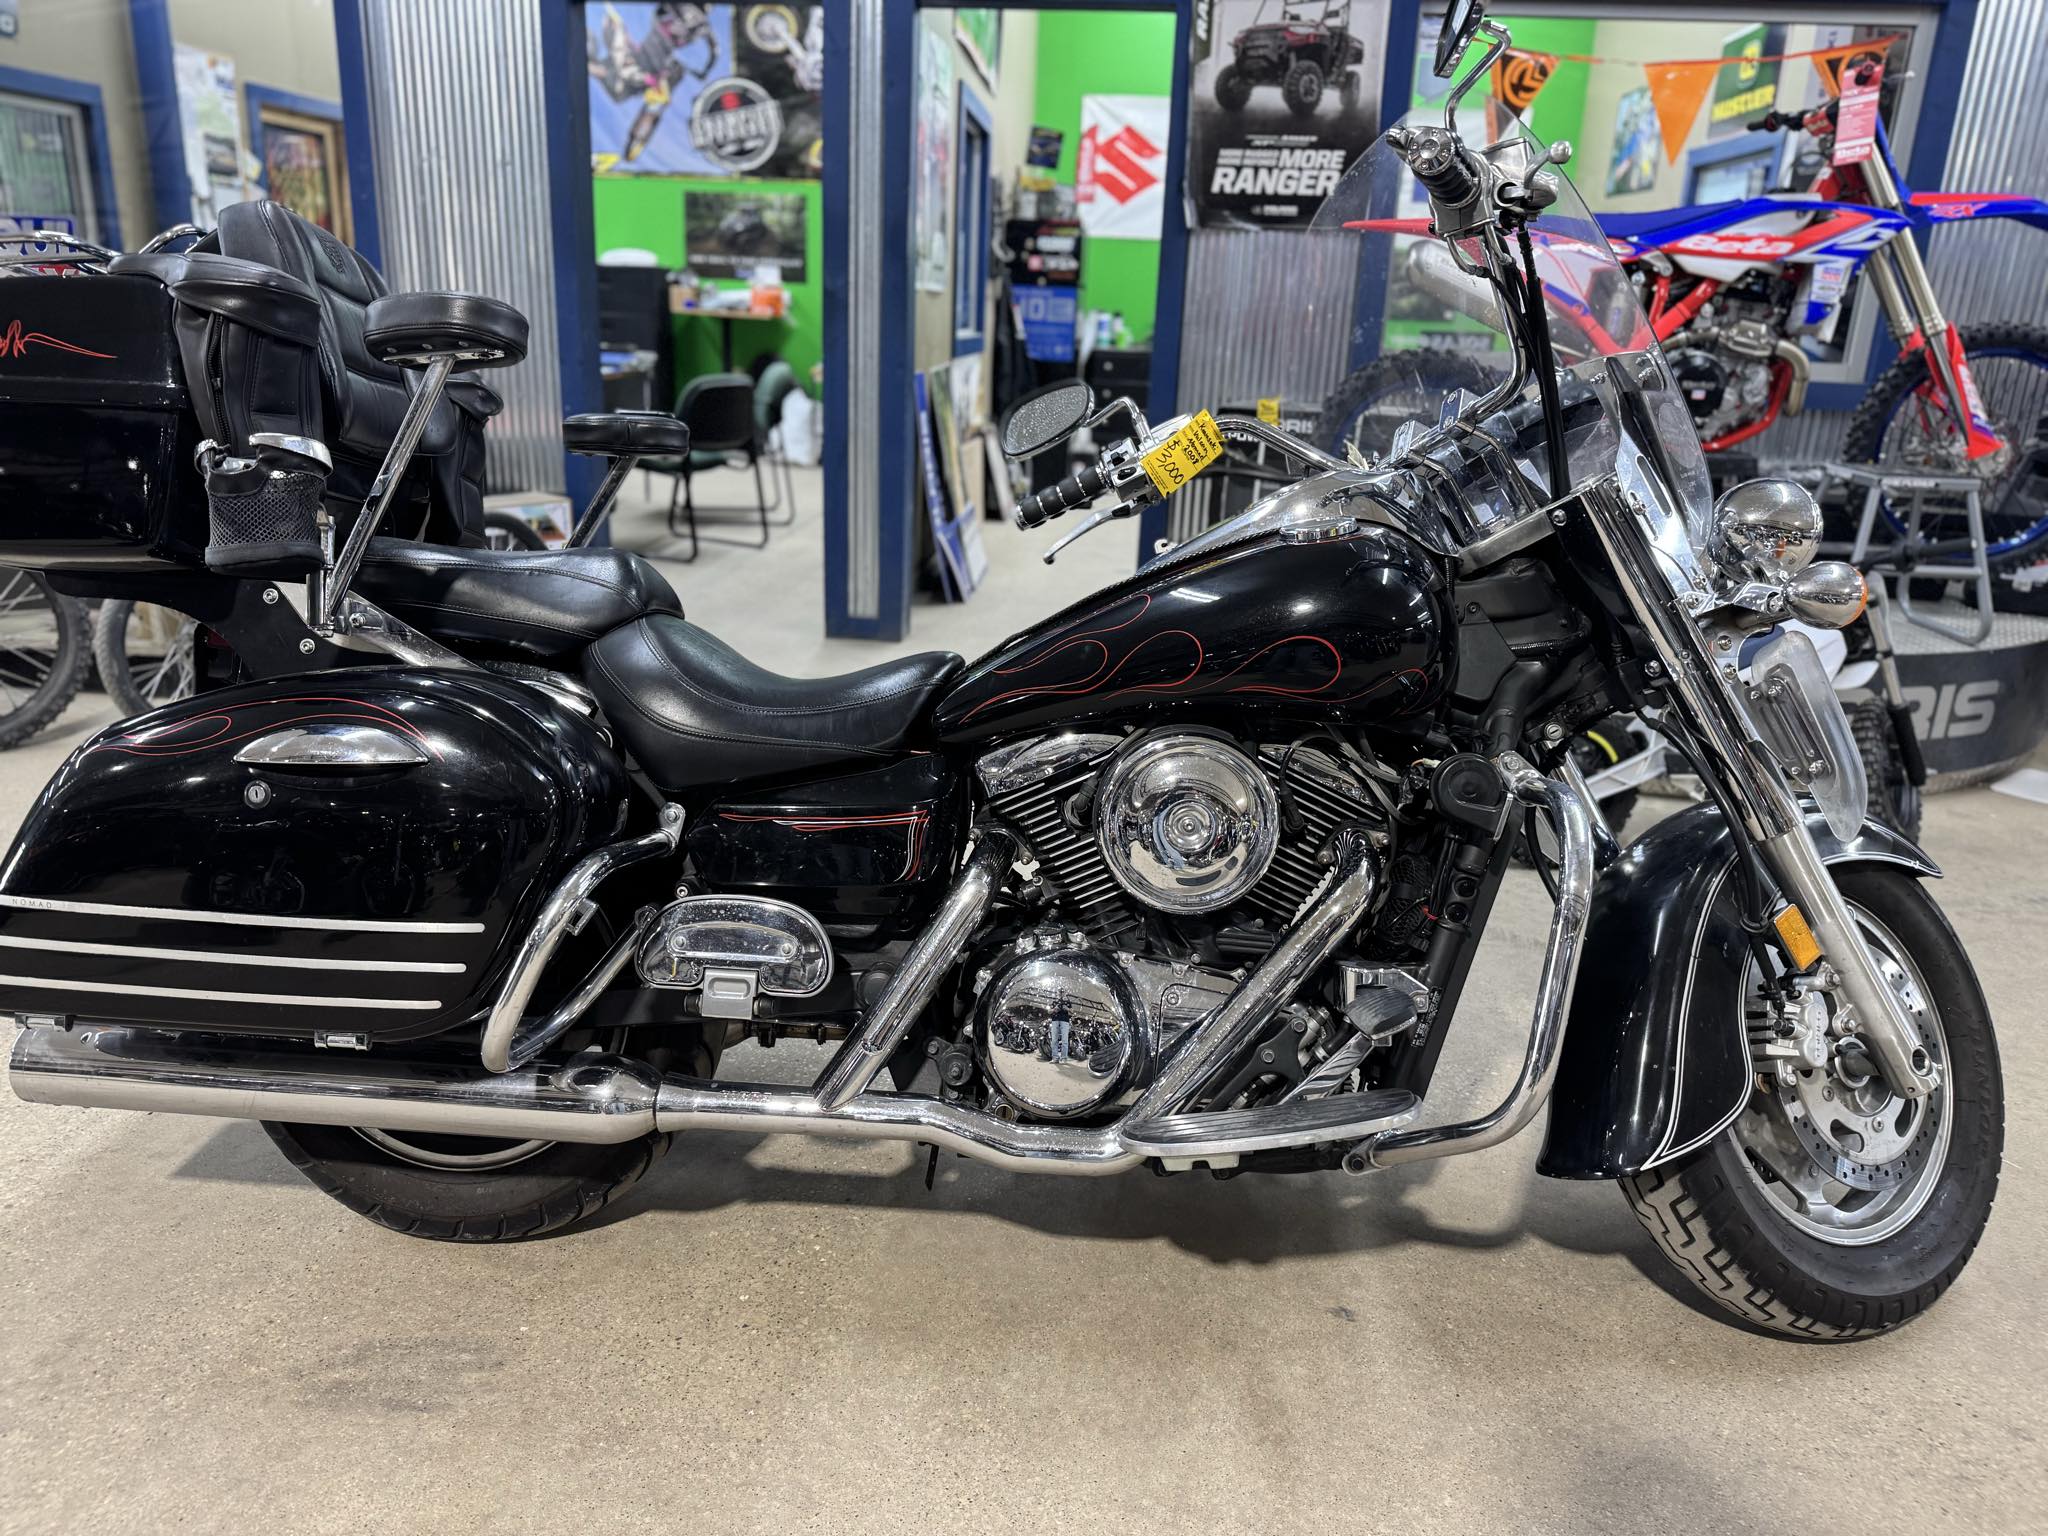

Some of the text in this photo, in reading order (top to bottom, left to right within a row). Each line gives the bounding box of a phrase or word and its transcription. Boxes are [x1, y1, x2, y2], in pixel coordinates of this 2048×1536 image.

[1279, 149, 1346, 169] MORE
[1210, 167, 1342, 197] RANGER
[1678, 234, 1795, 254] Beta
[1156, 448, 1184, 485] 3,000
[13, 898, 52, 908] NOMAD
